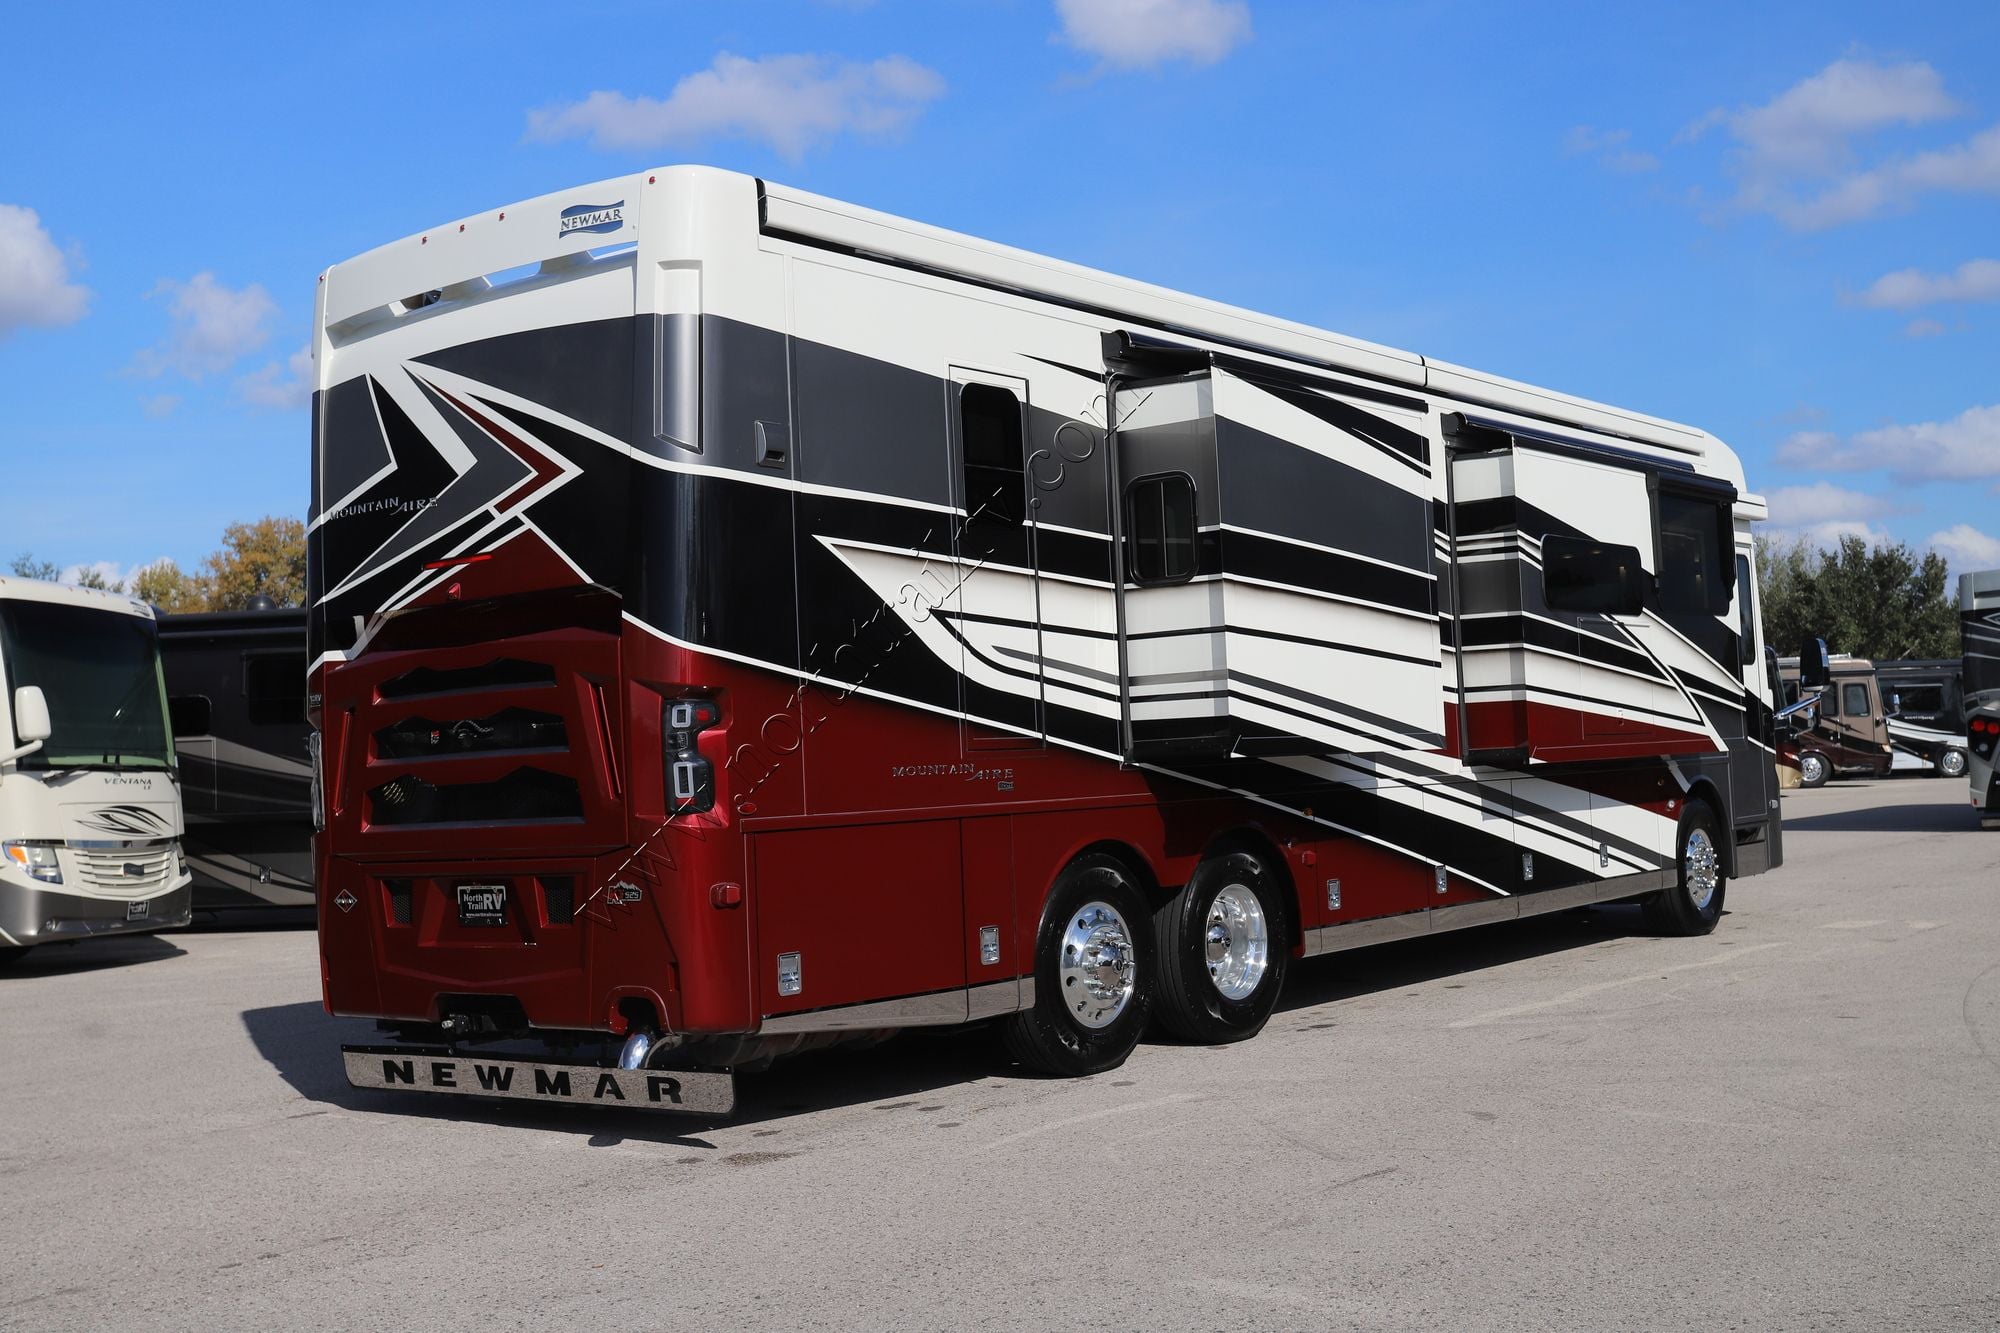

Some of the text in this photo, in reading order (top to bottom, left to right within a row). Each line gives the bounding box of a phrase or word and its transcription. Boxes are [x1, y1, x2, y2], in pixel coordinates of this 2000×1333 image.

[560, 209, 623, 231] NEWMAR
[329, 496, 438, 520] MOUNTAIN AIRE
[104, 777, 152, 785] VENTANA
[892, 763, 1014, 781] MOUNTAIN AIRE
[463, 893, 503, 910] North RV
[467, 902, 484, 910] Trail
[382, 1059, 683, 1104] NEWMAR
